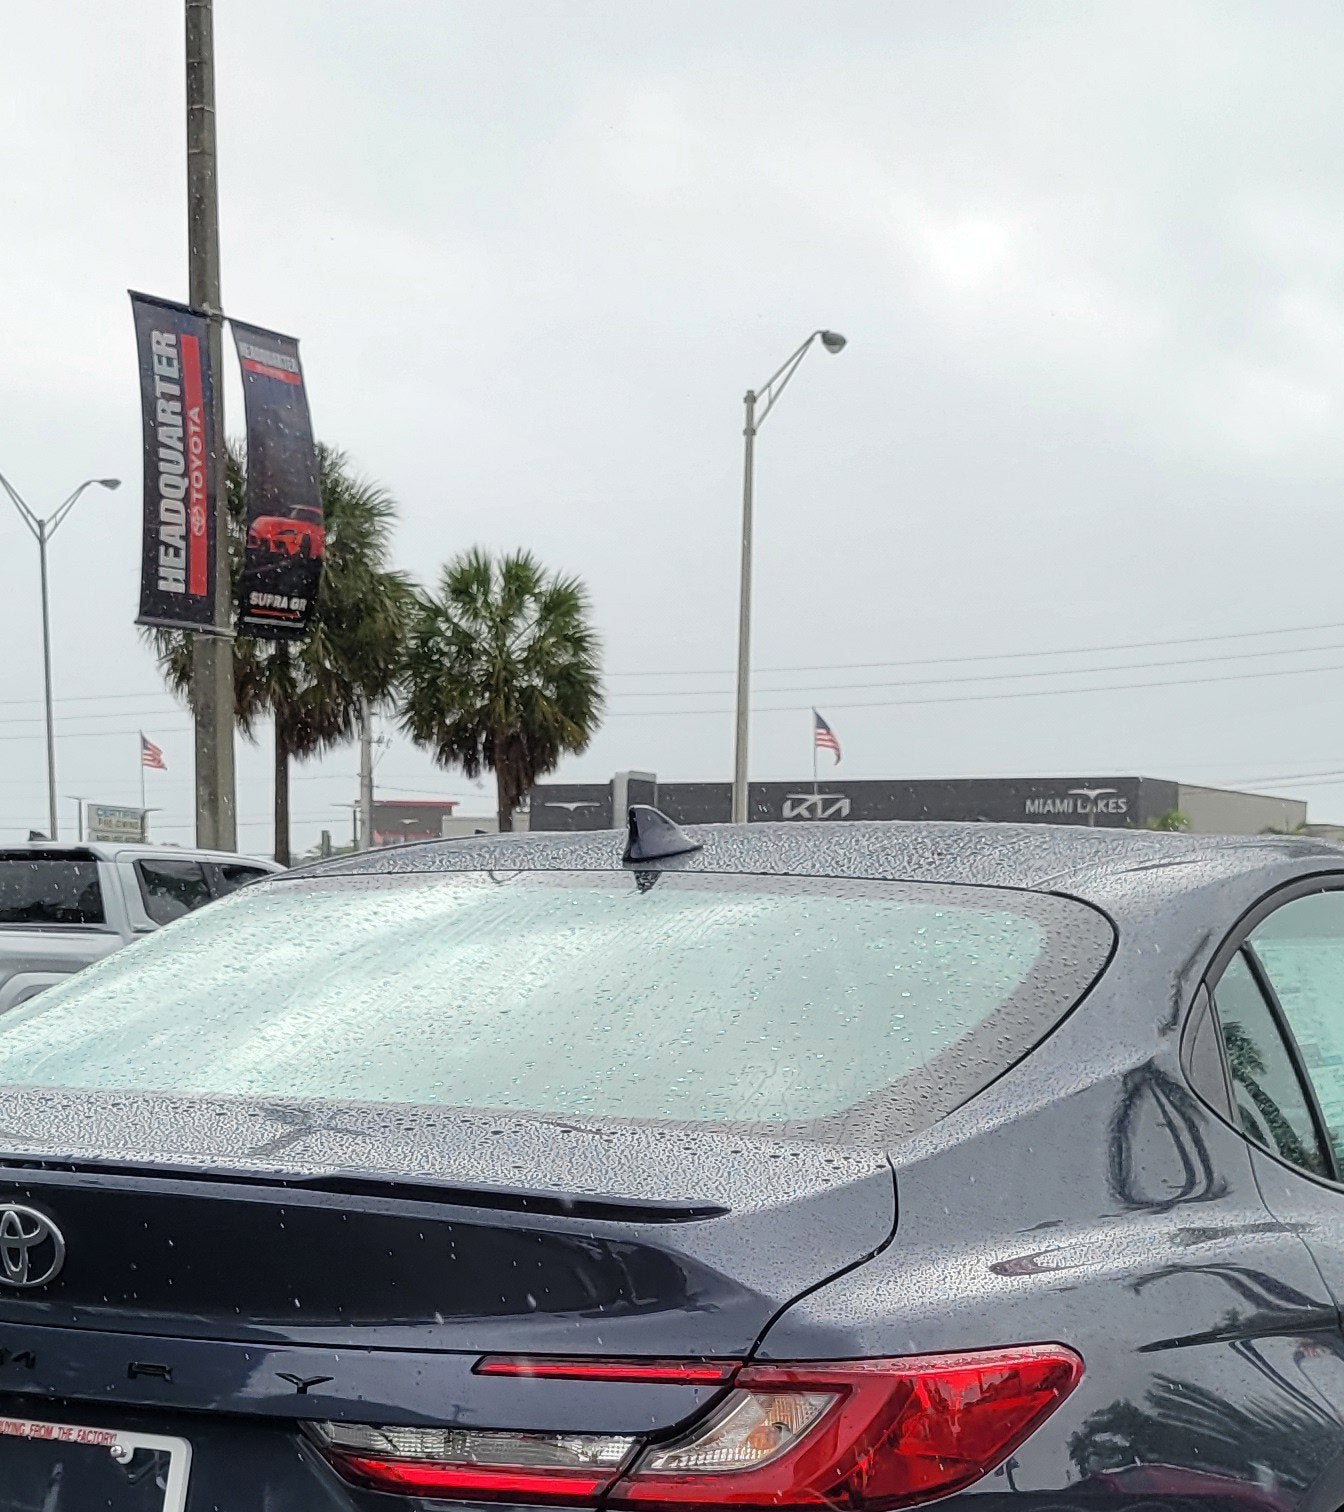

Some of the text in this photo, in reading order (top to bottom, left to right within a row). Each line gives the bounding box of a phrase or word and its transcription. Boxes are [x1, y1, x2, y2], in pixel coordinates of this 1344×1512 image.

[150, 327, 188, 594] HEADQUARTER
[188, 406, 205, 501] TOYOTA
[782, 797, 852, 819] KIA
[1025, 798, 1074, 815] MIAMI
[29, 1423, 54, 1439] FROM
[58, 1426, 74, 1441] THE
